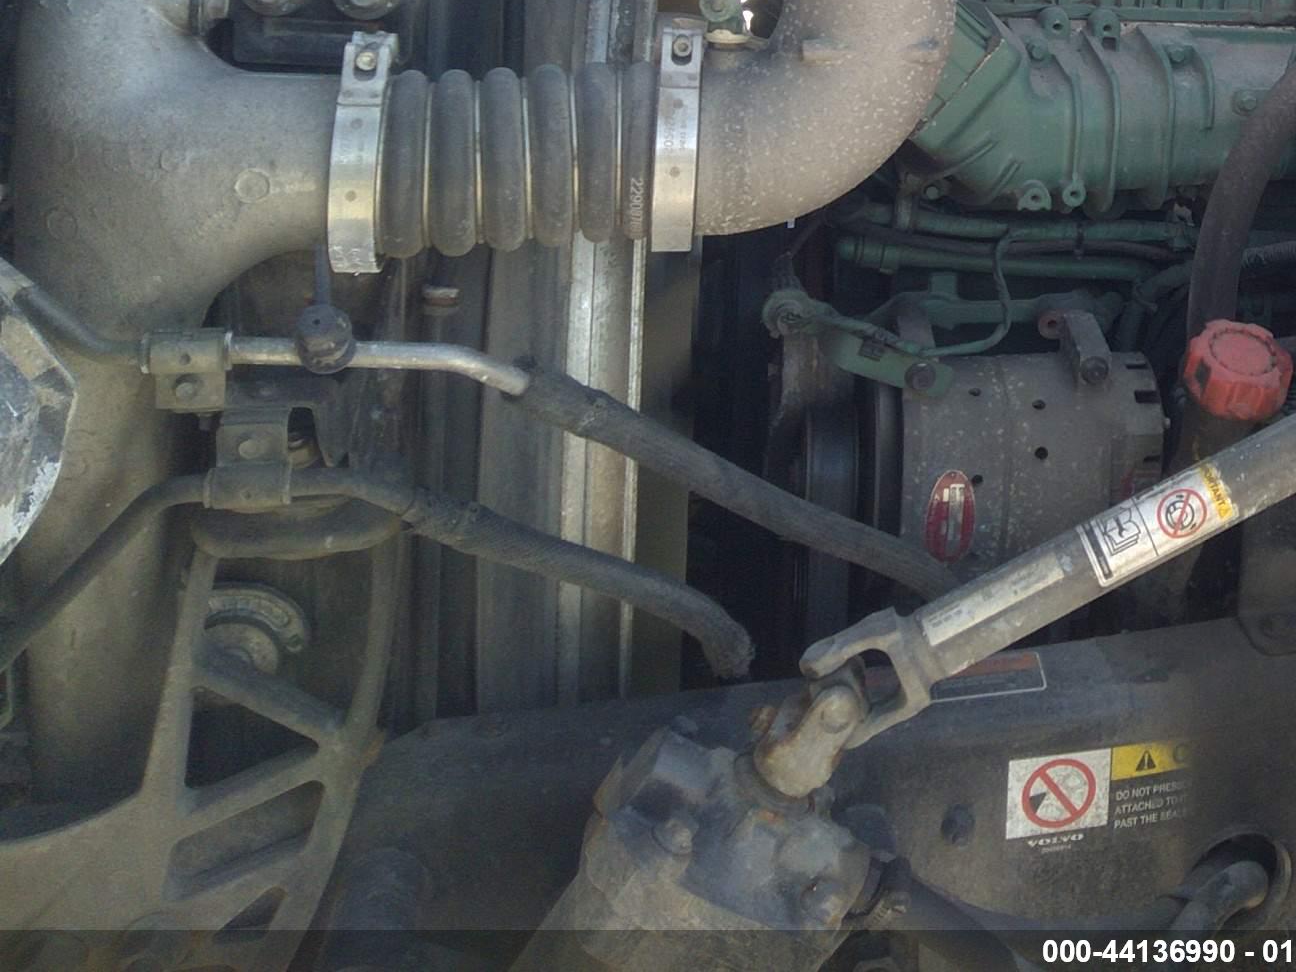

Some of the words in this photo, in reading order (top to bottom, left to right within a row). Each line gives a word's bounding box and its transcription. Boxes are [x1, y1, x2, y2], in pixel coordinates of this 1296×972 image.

[1116, 789, 1130, 801] DO
[1132, 786, 1151, 797] NOT
[1114, 816, 1138, 829] PAST
[1140, 813, 1158, 824] THE
[1027, 832, 1085, 848] VOLVO
